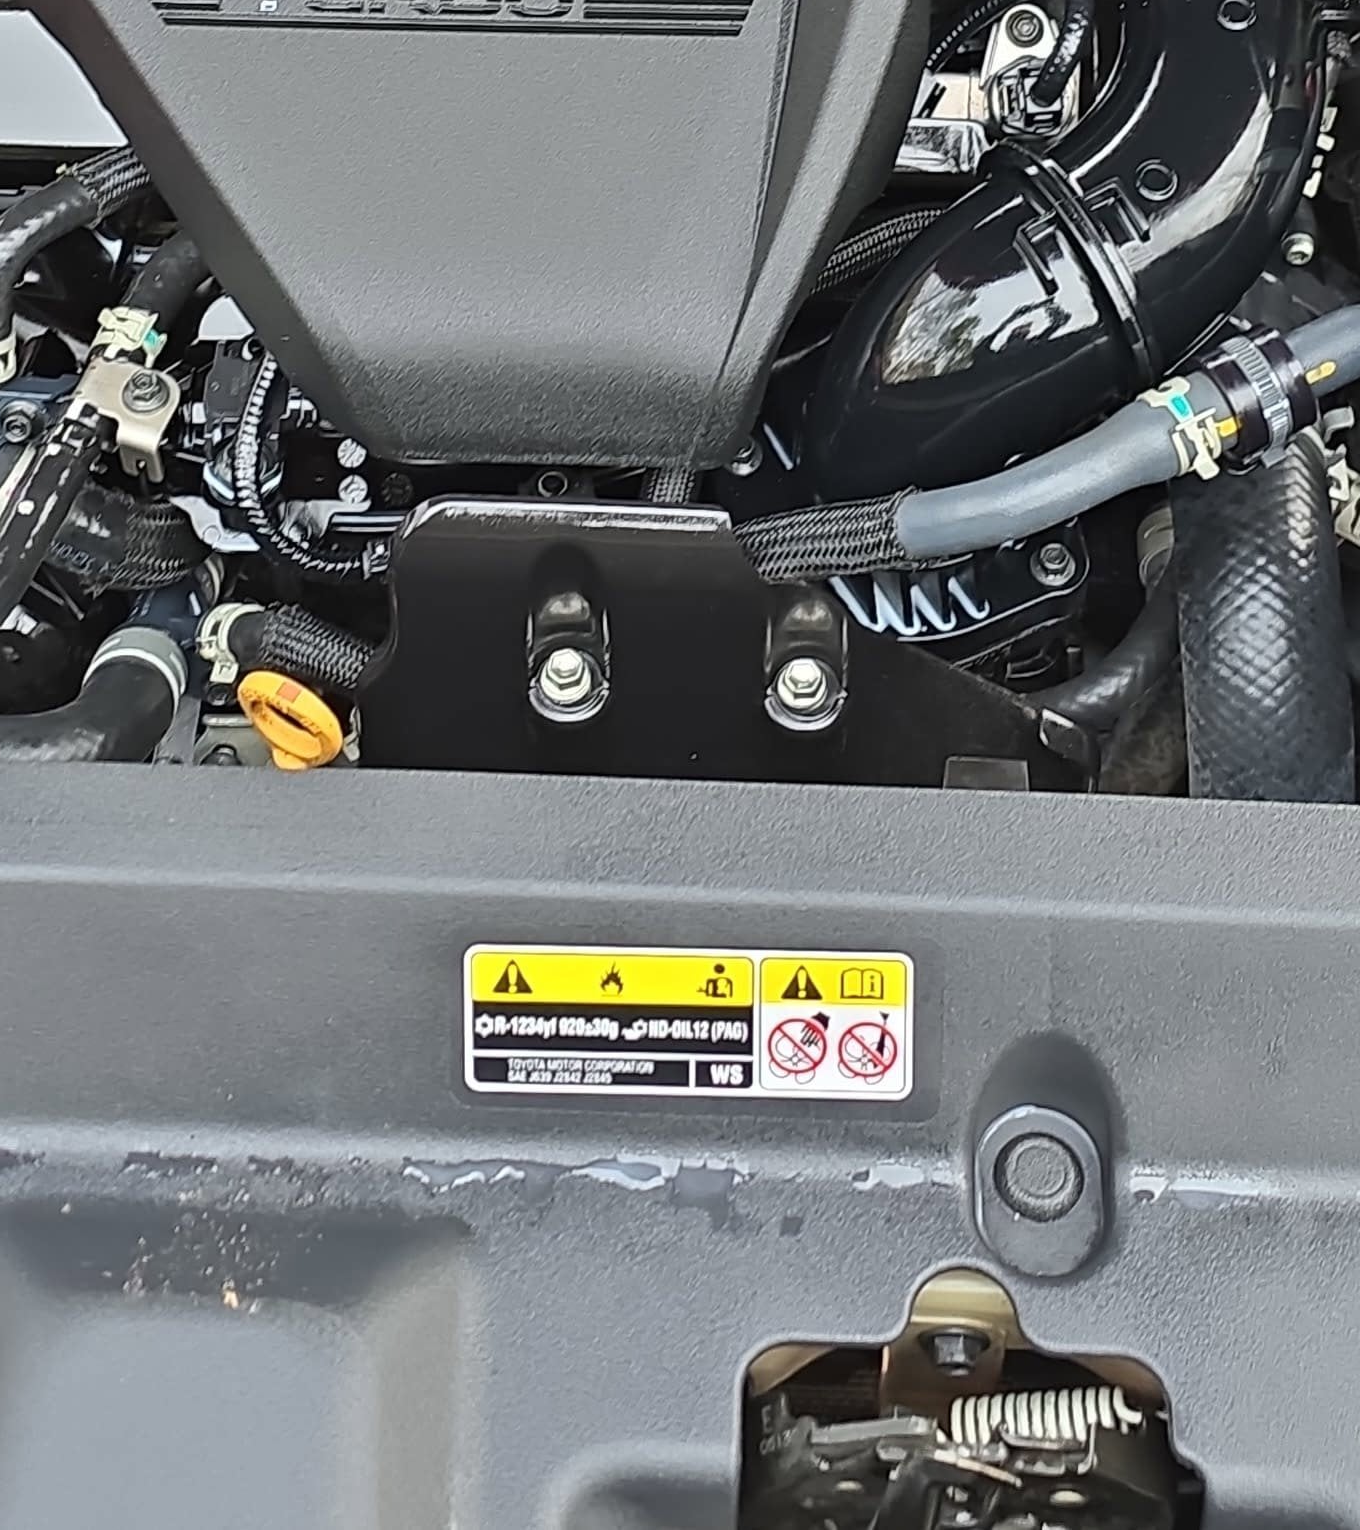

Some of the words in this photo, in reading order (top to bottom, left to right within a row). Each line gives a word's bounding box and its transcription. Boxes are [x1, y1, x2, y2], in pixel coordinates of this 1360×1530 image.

[711, 1020, 749, 1043] (PAG)
[507, 1058, 545, 1070] TOYOTA
[547, 1059, 583, 1072] MOTOR
[584, 1060, 655, 1075] CORPORATION
[710, 1063, 744, 1085] WS
